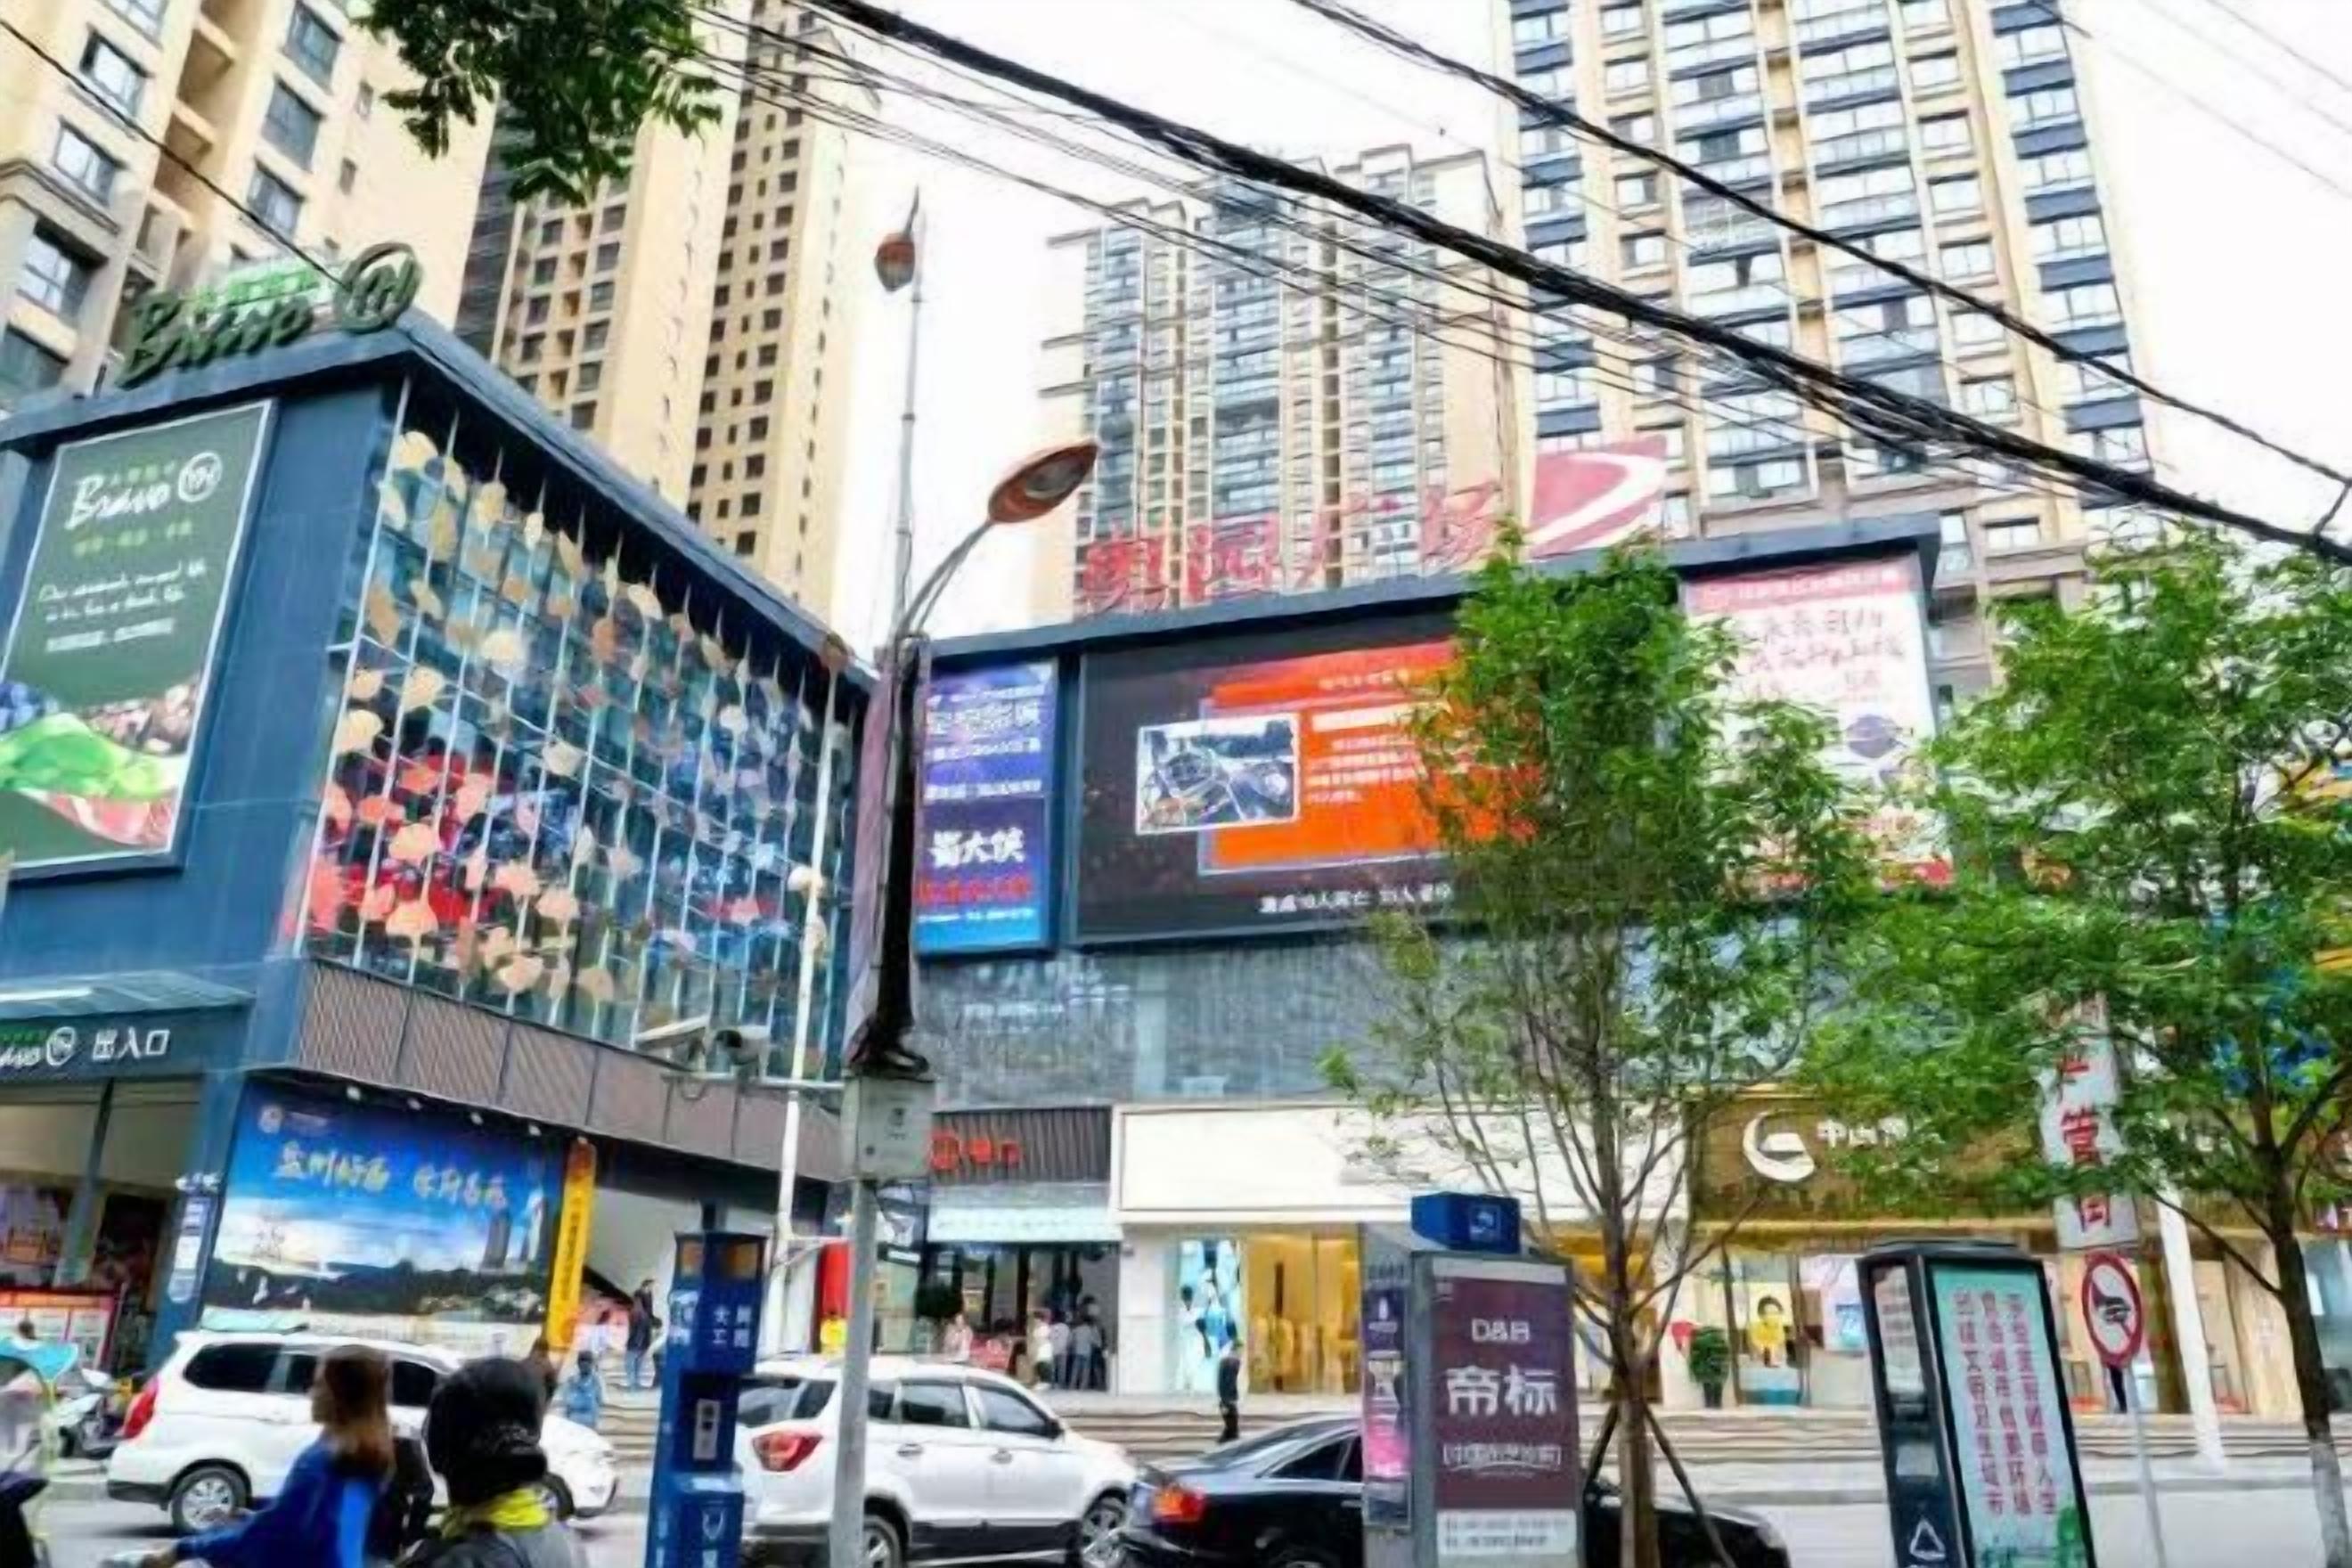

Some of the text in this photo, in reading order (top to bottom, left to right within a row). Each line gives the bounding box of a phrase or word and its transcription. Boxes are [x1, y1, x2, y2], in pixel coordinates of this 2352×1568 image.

[65, 474, 172, 530] Bravo
[92, 1026, 171, 1061] 出入口
[1447, 1364, 1558, 1417] 帝标
